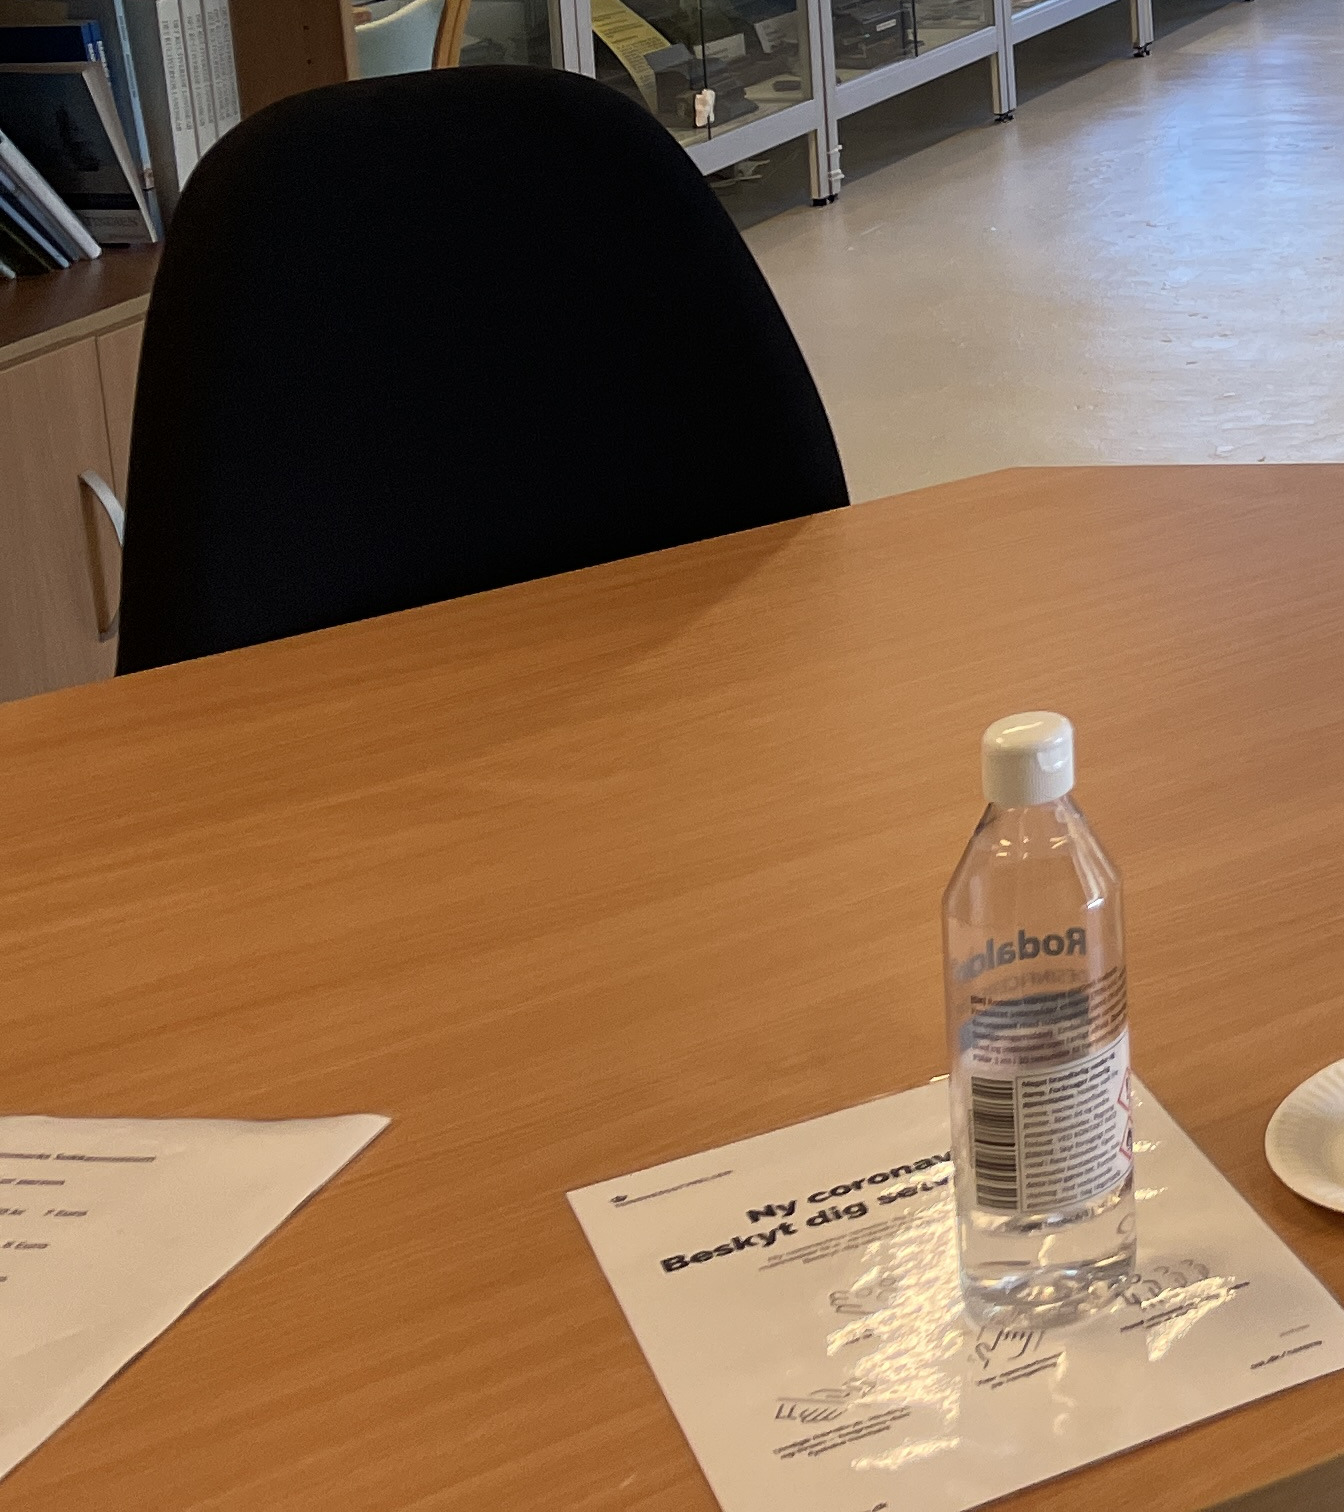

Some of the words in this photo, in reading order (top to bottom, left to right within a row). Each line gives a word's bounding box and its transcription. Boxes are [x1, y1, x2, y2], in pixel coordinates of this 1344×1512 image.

[746, 1199, 797, 1224] Ny
[806, 1150, 952, 1205] coronav
[661, 1222, 798, 1273] Beskyt
[806, 1201, 869, 1227] dig
